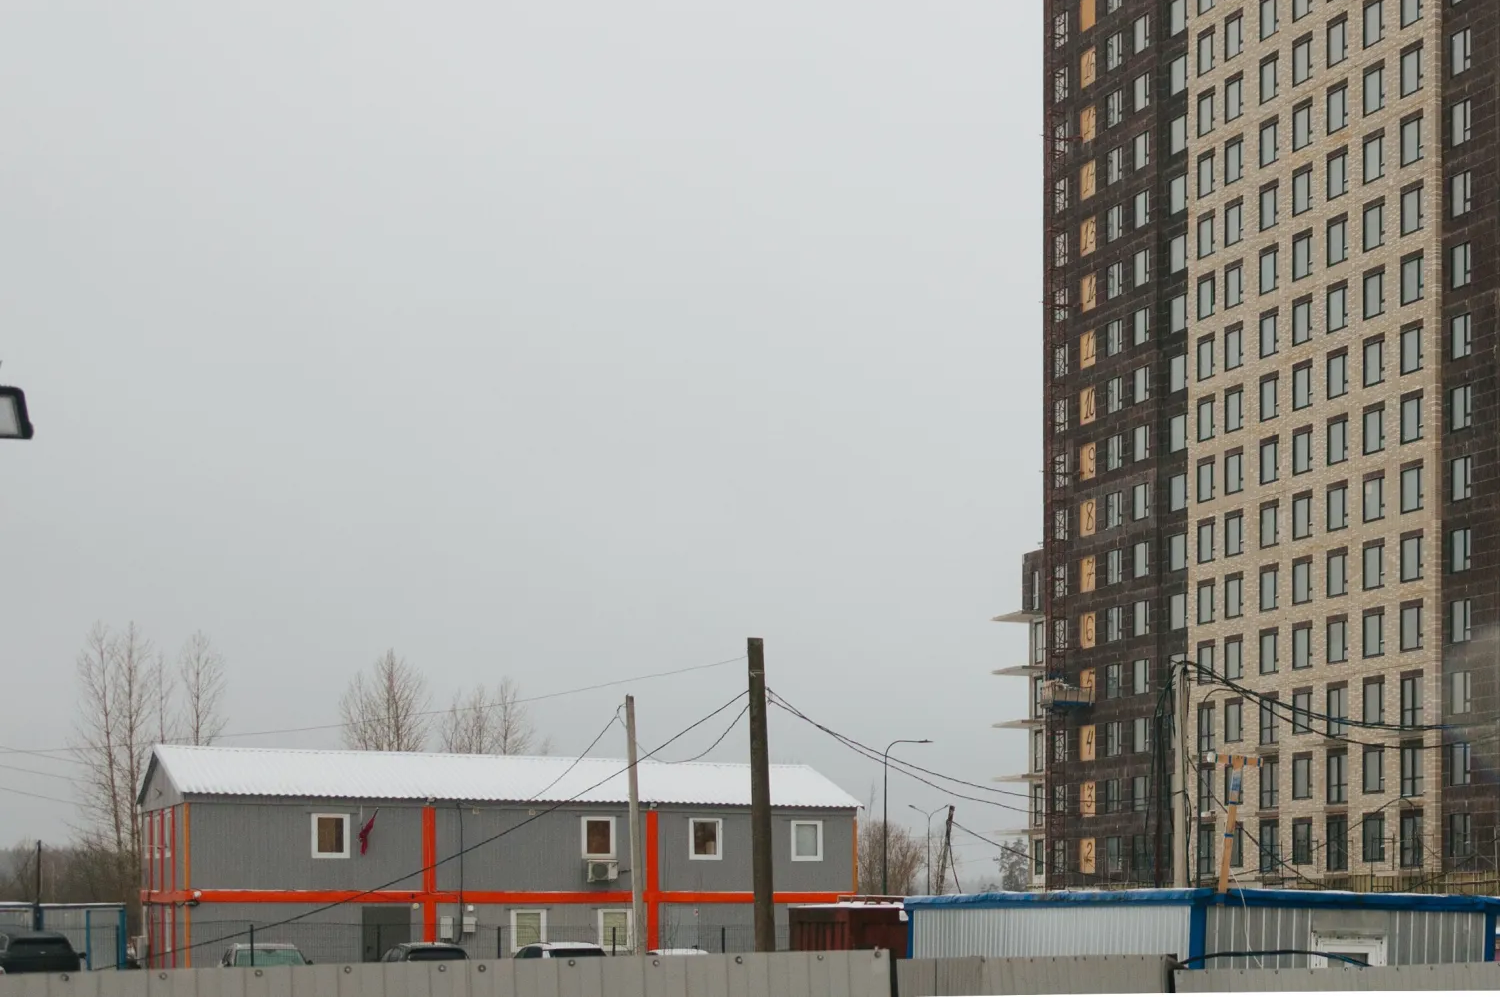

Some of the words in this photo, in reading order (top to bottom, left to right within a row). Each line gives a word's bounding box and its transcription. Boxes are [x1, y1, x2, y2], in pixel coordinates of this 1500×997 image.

[1089, 447, 1095, 474] 9
[1086, 501, 1094, 532] 8
[1086, 615, 1094, 642] 6
[1086, 730, 1094, 756] 4
[1086, 784, 1094, 808] 3
[1083, 842, 1093, 863] 2
